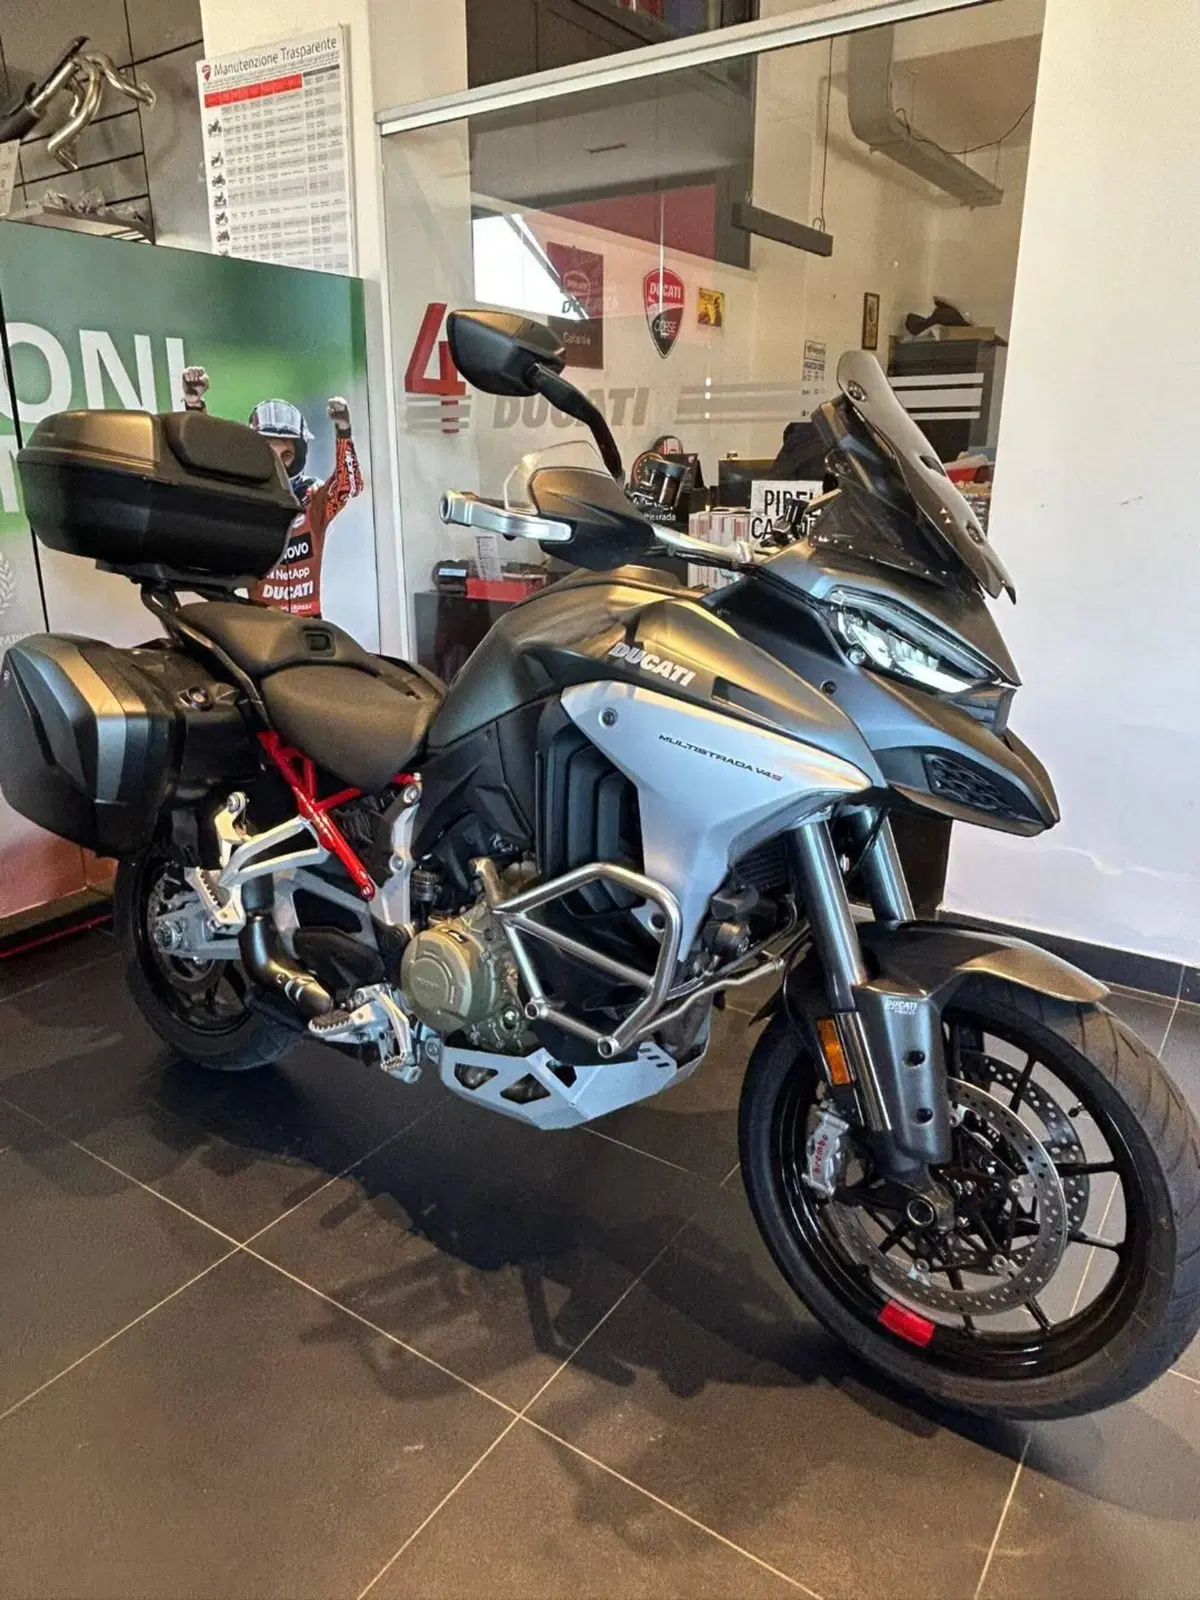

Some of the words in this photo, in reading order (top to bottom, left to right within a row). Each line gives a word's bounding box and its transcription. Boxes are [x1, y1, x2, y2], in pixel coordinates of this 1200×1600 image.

[214, 53, 279, 77] Manutenzione
[280, 38, 337, 61] Trasparente
[262, 580, 314, 600] DUCATI
[608, 642, 696, 686] DUCATI
[658, 734, 753, 773] MULTISTRADA
[755, 768, 784, 782] V4S
